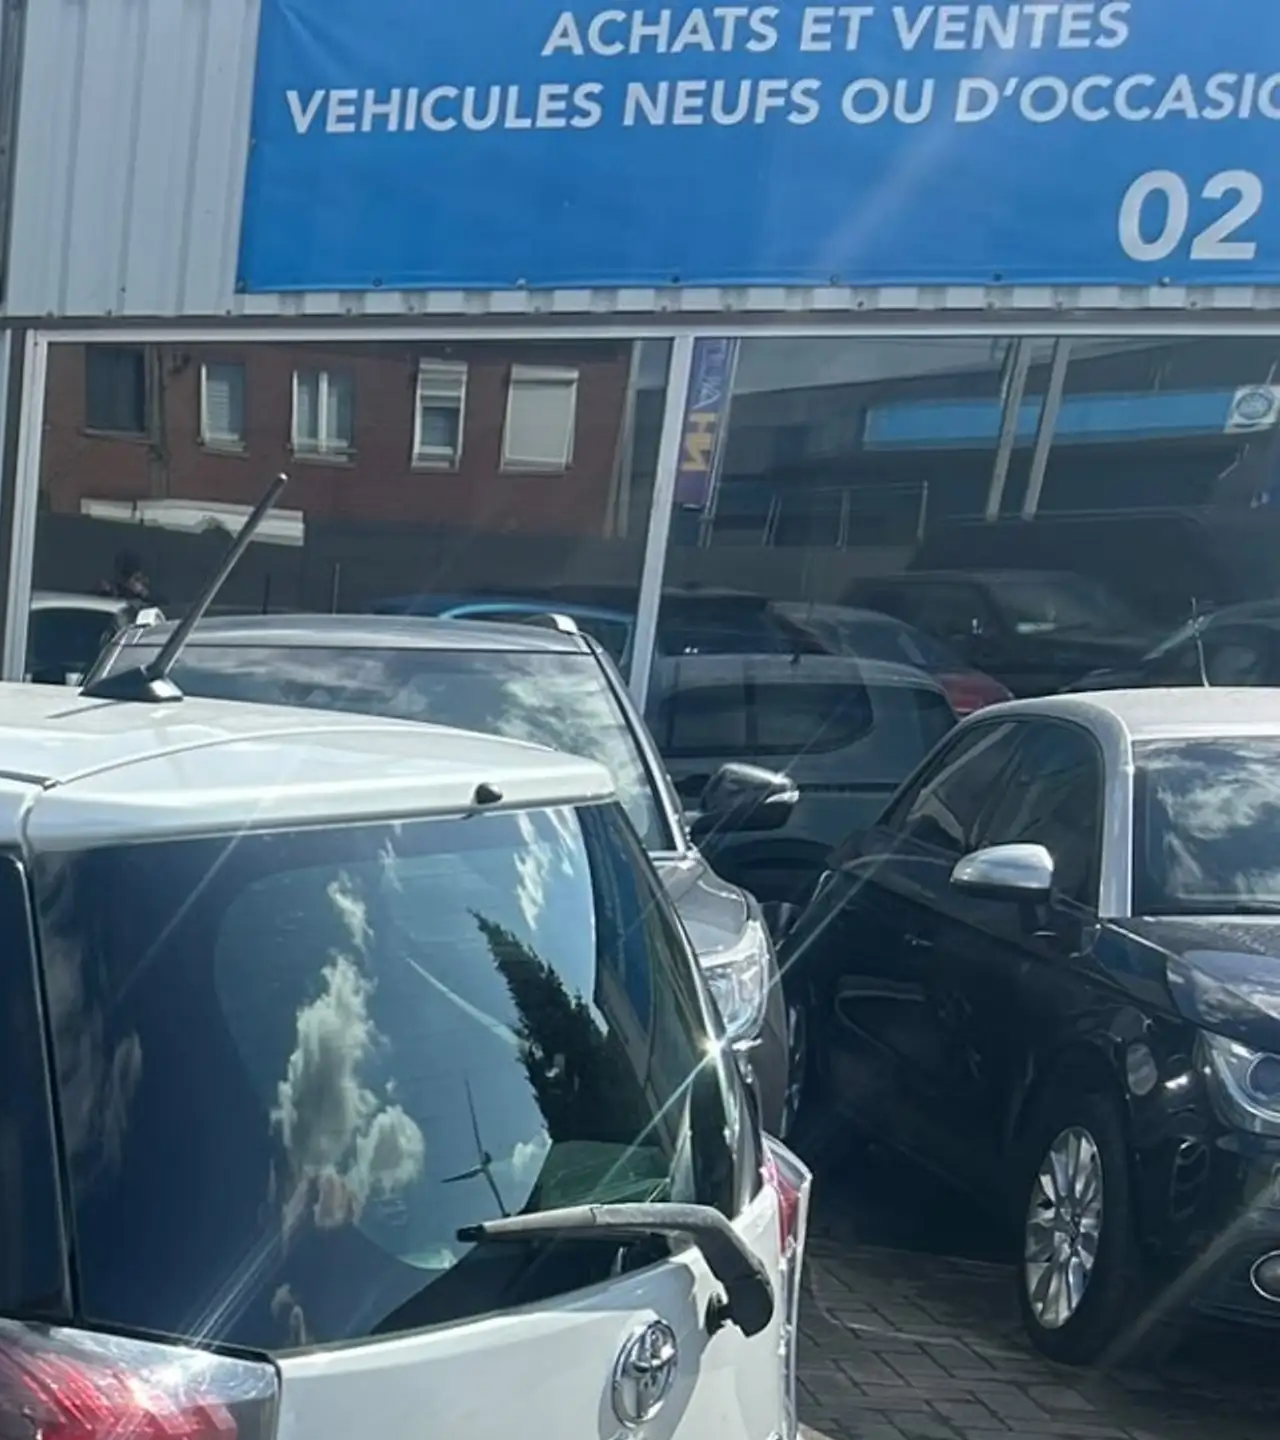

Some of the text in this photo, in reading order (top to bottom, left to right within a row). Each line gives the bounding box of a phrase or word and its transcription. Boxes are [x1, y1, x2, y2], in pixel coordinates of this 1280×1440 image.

[541, 1, 1132, 57] ACHATS ET VENTES
[285, 82, 604, 134] VEHICULES
[622, 78, 822, 127] NEUFS
[841, 78, 936, 125] OU
[1117, 168, 1264, 262] 02
